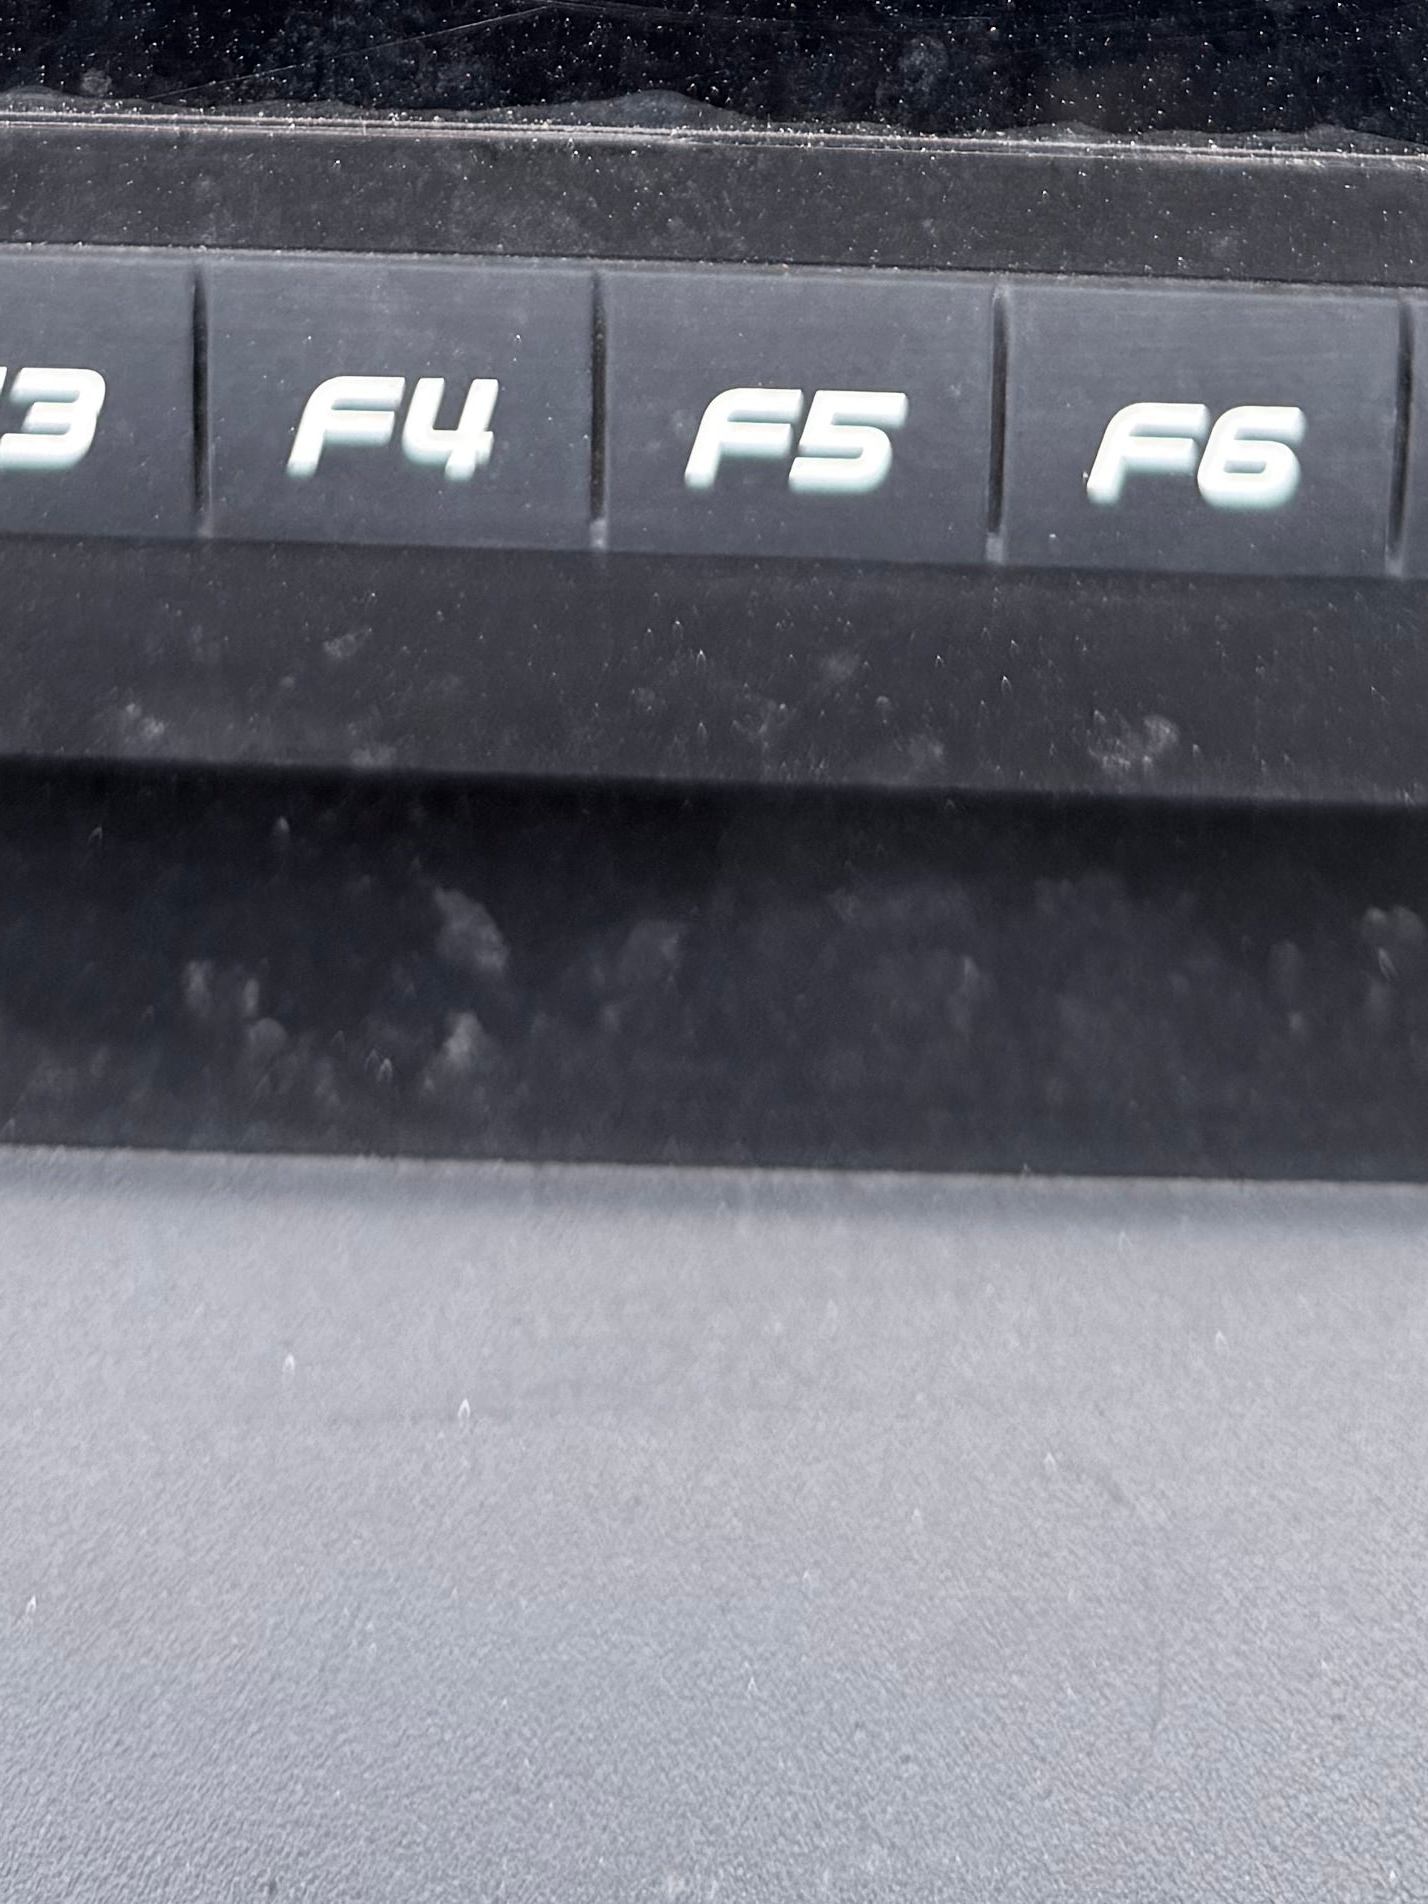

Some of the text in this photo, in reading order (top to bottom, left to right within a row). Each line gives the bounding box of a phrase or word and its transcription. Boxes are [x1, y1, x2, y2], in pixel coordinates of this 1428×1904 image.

[290, 375, 501, 485] F4
[686, 384, 906, 497] F5
[1091, 398, 1305, 514] F6
